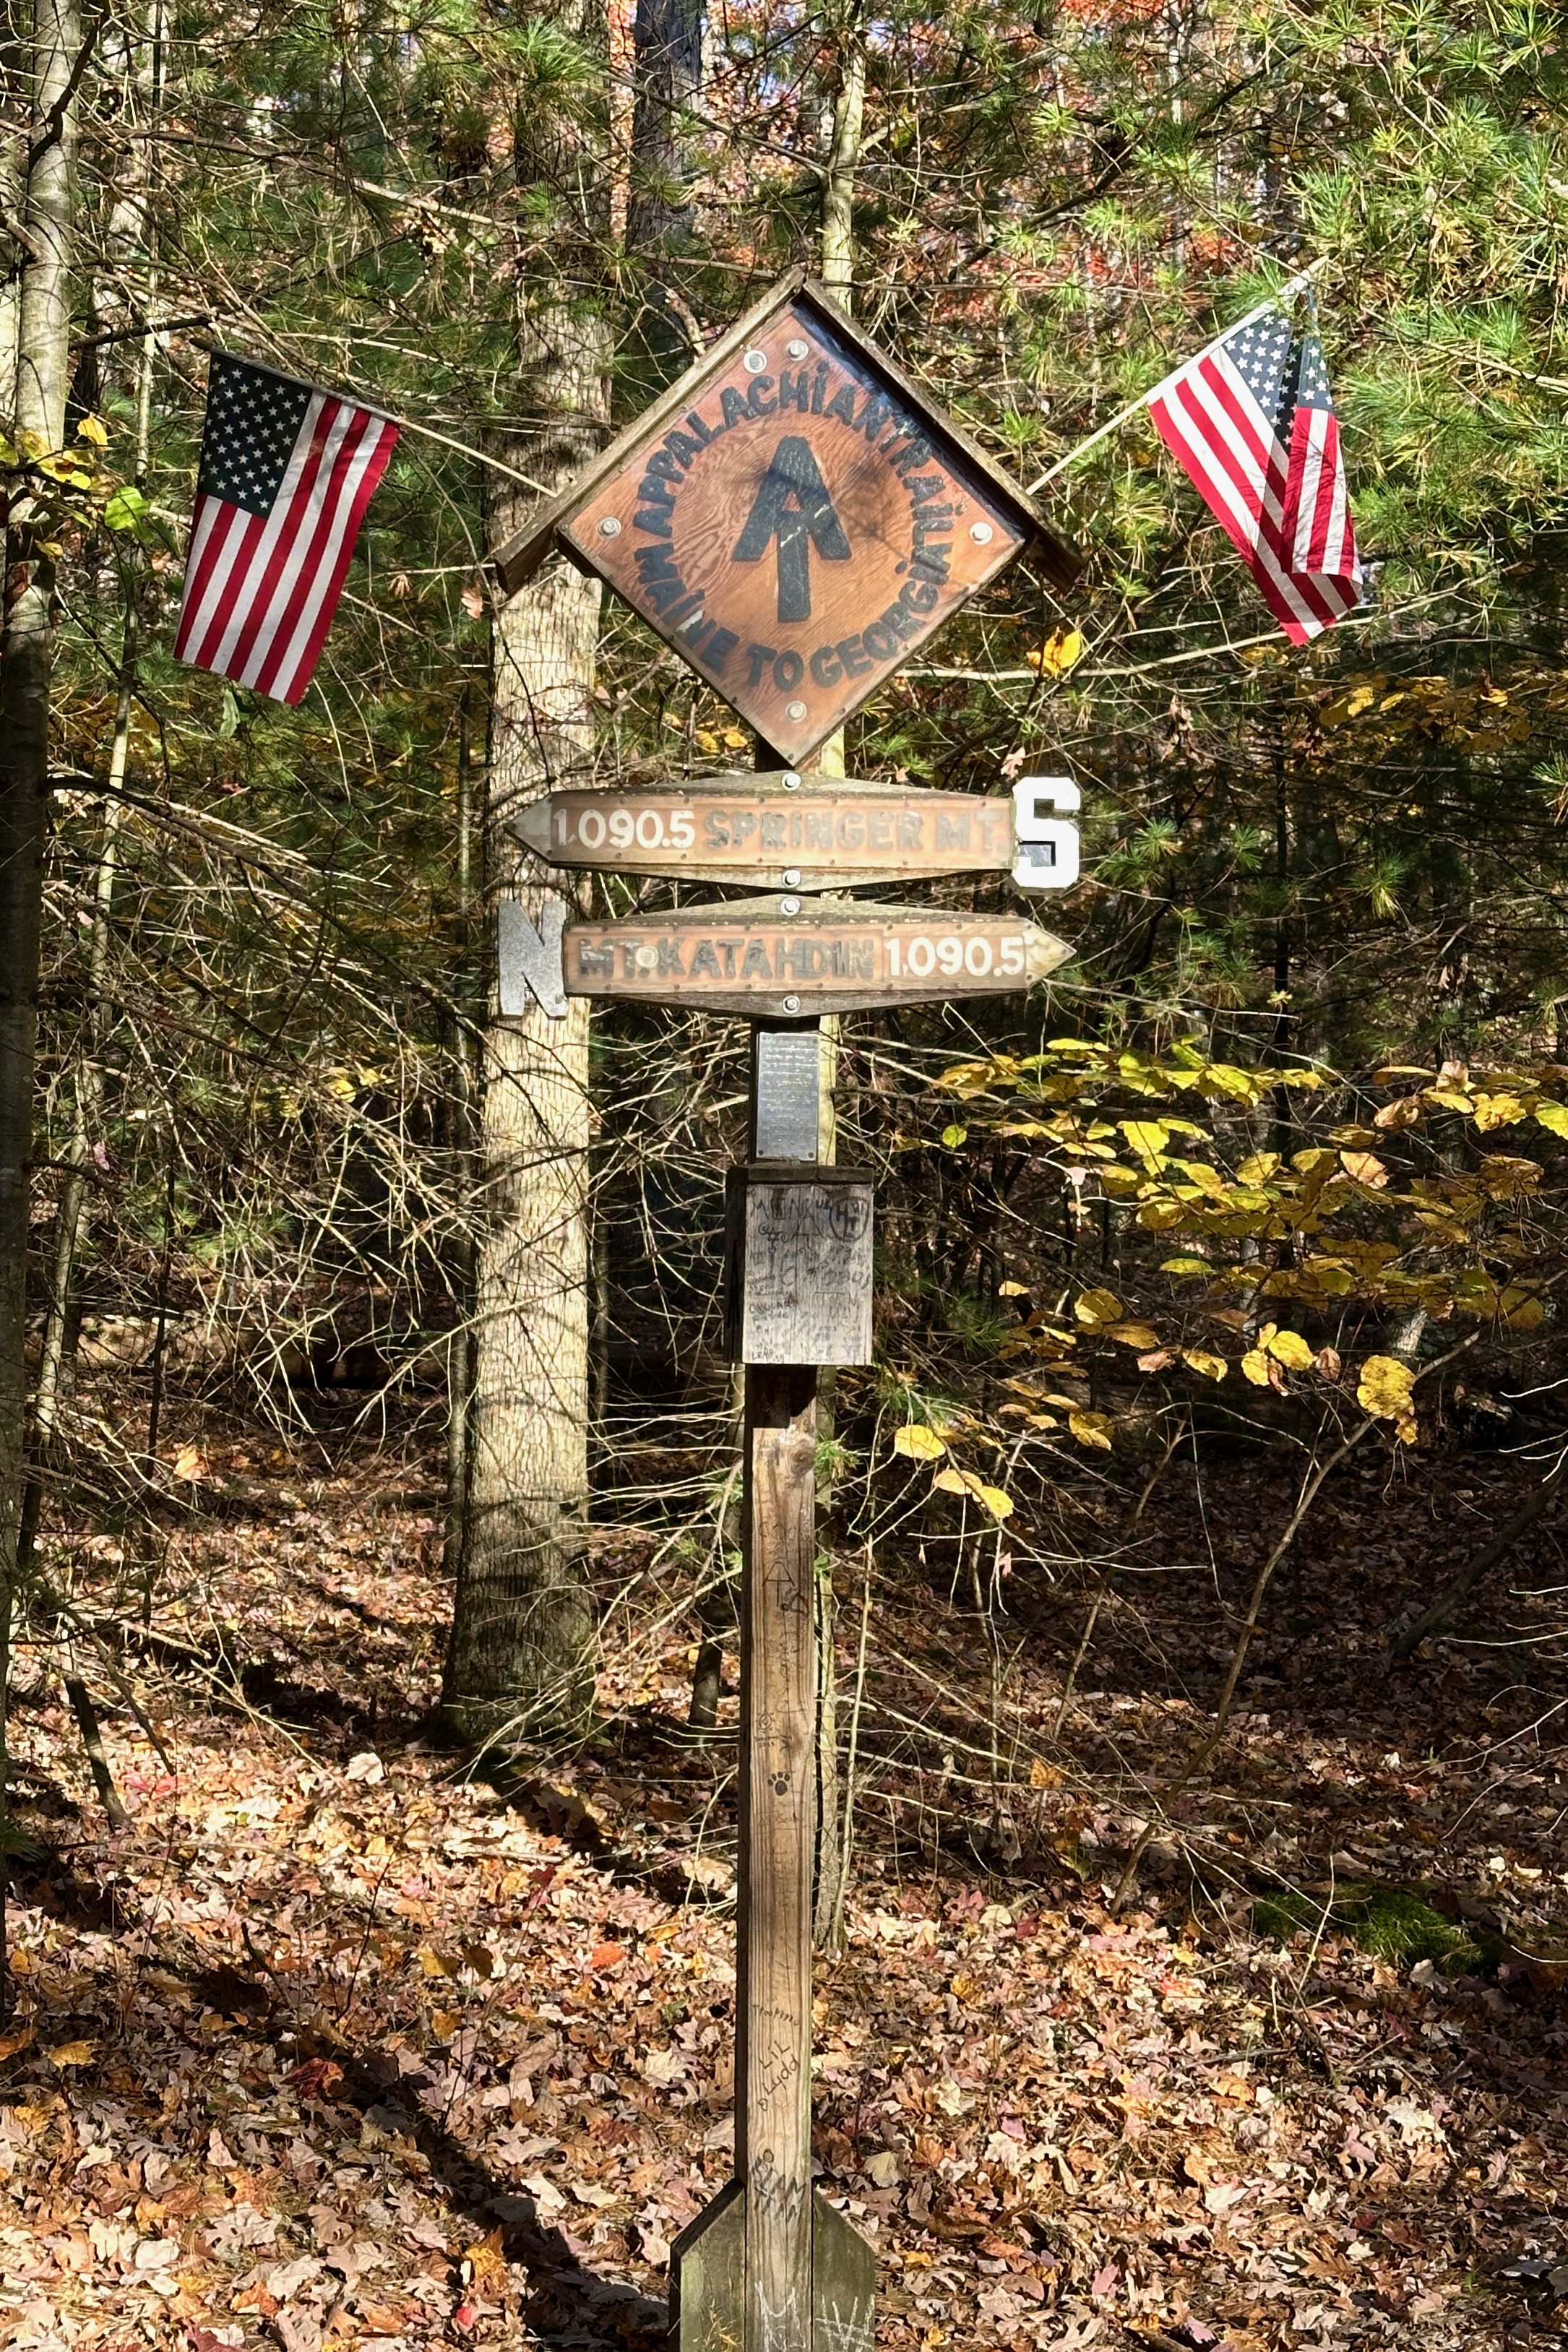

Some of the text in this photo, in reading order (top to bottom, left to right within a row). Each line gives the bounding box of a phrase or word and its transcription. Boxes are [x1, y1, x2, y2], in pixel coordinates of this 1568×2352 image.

[633, 361, 967, 546] APPALACHIAN TRAIL
[634, 542, 953, 692] MAINE TO GEORGIA
[705, 809, 923, 852] SPRINGER
[1012, 776, 1081, 889] S
[498, 900, 569, 1018] N
[657, 936, 875, 979] KATAHDIN
